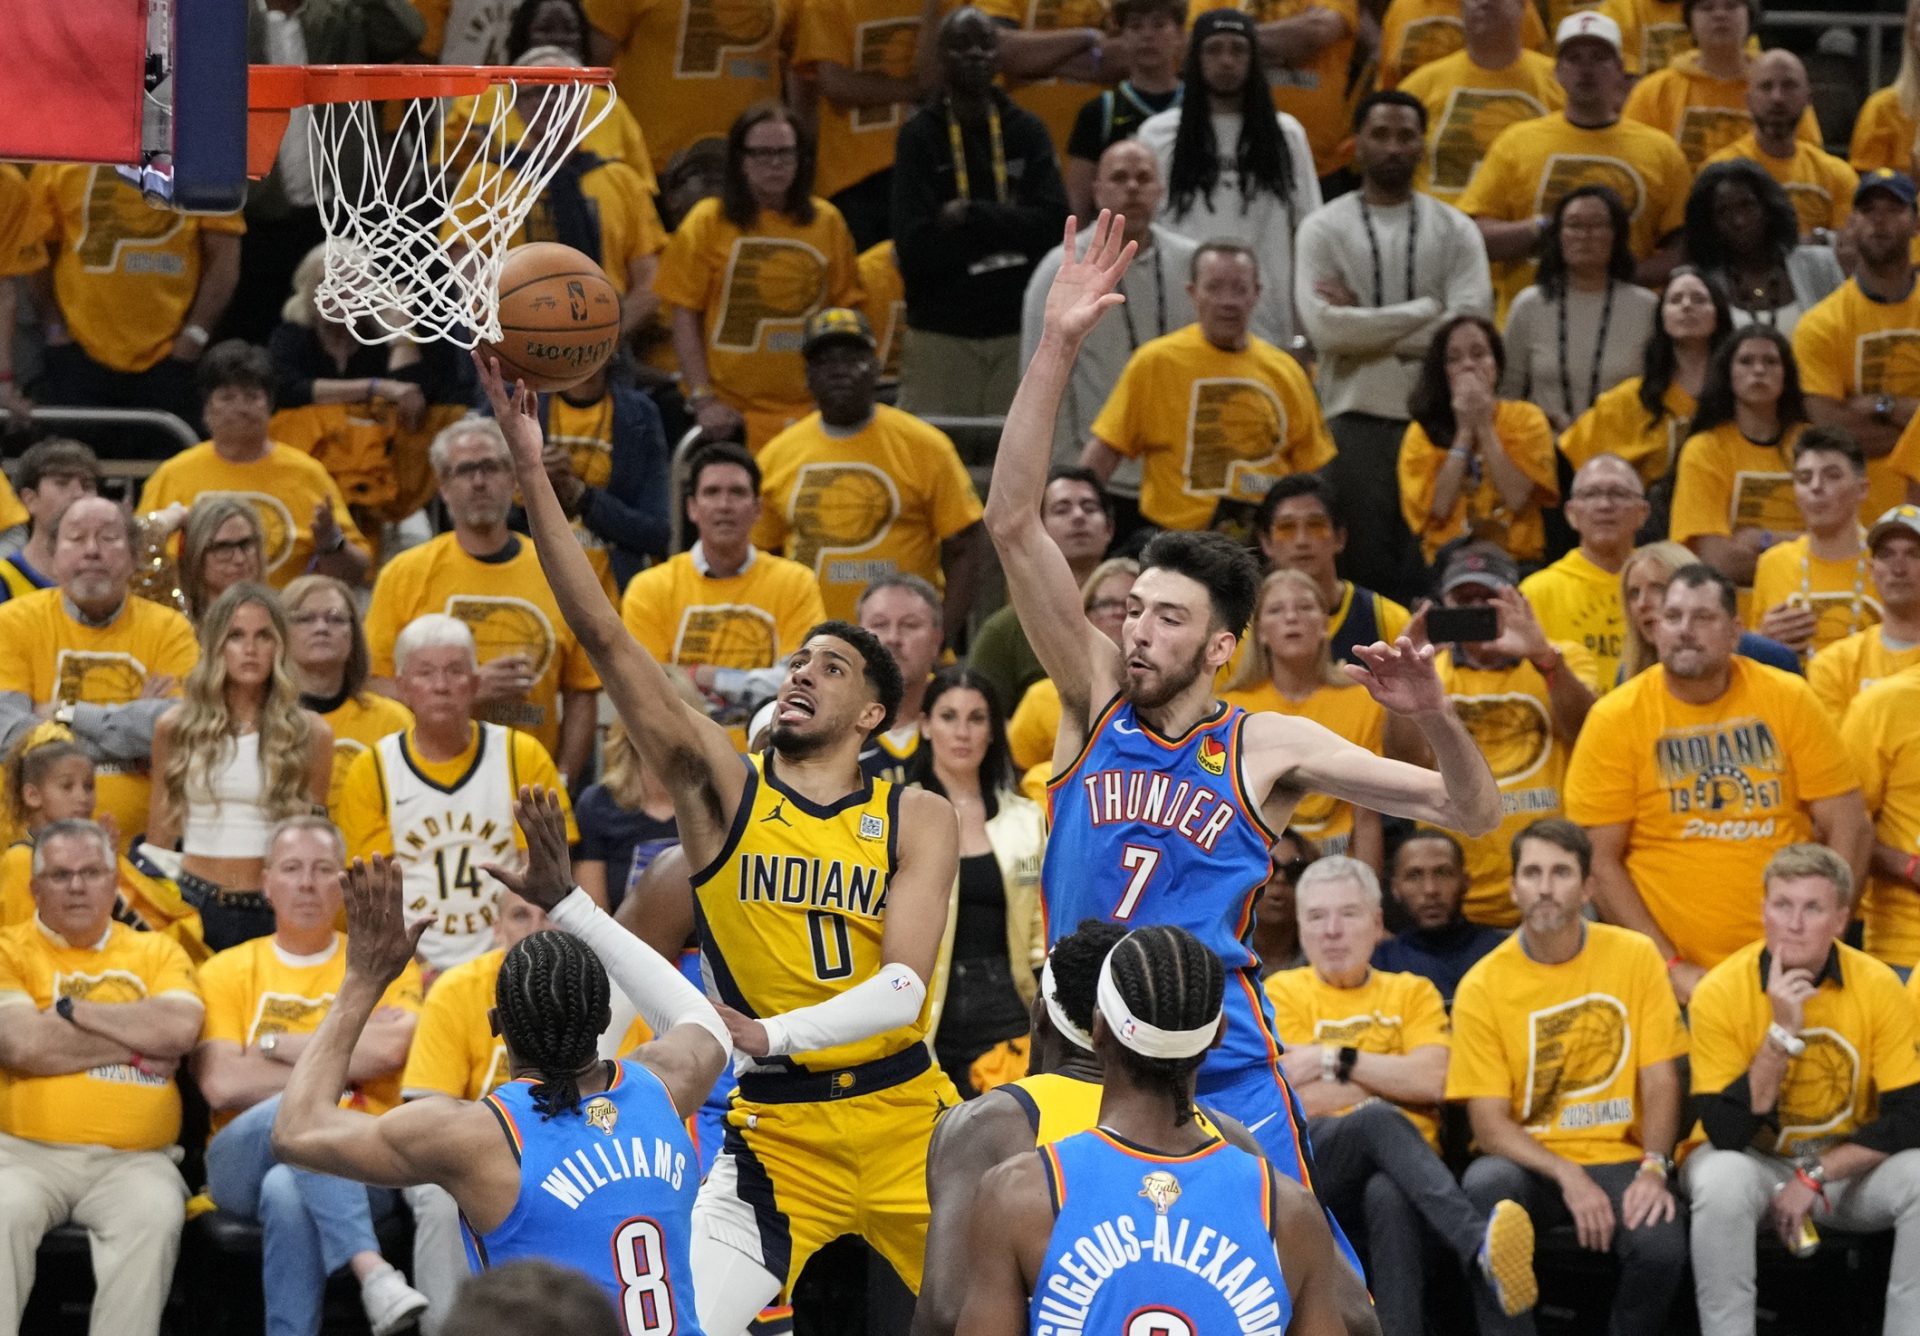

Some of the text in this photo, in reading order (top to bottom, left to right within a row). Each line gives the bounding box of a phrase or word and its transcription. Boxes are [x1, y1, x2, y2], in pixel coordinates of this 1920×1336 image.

[1197, 751, 1222, 774] Love's
[1656, 721, 1779, 781] INDIANA
[398, 811, 510, 862] INDIANA
[1083, 769, 1236, 854] THUNDER
[433, 845, 483, 901] 14
[1111, 842, 1163, 920] 7
[805, 908, 855, 982] 0
[540, 1137, 686, 1210] WILLIAMS
[609, 1215, 678, 1336] 8
